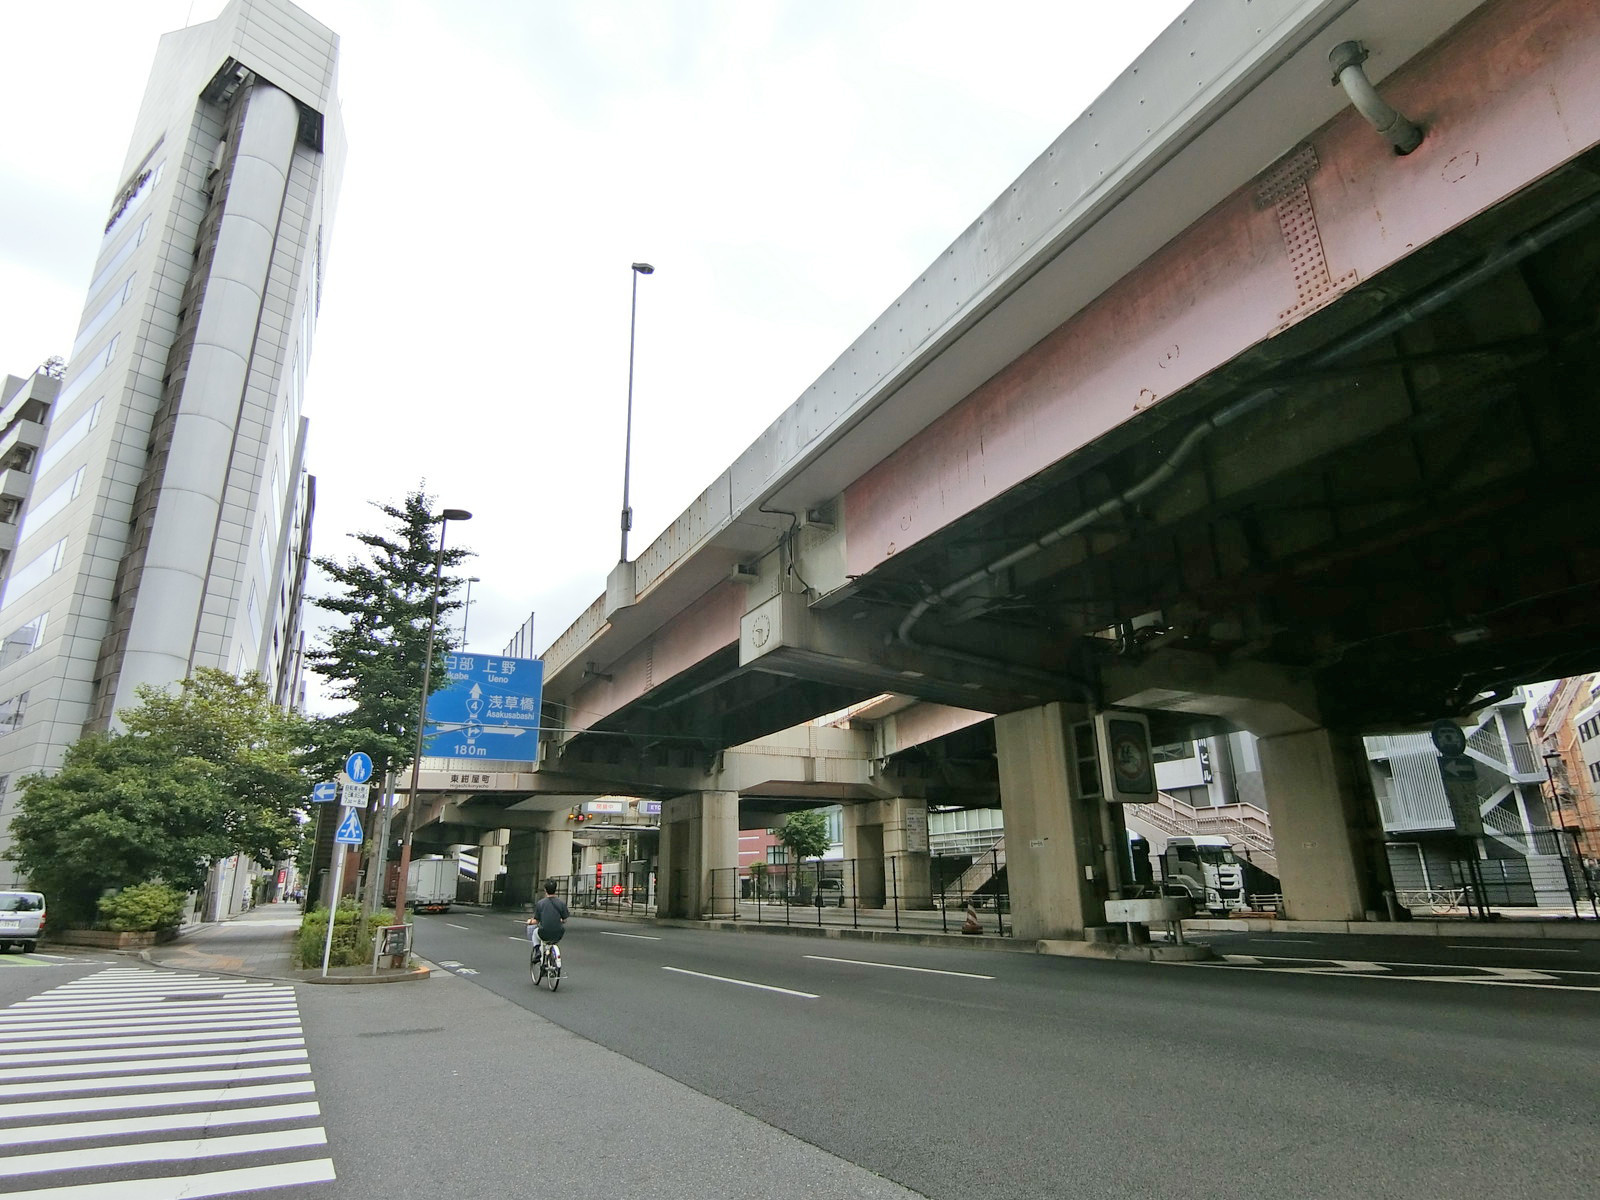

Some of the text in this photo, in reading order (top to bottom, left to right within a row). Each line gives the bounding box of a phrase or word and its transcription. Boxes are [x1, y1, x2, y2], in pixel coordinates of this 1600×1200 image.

[444, 655, 516, 675] 日部 上野
[488, 674, 509, 684] Ueno
[470, 701, 479, 711] 4
[488, 694, 535, 711] 浅草橋
[486, 710, 534, 720] Asakusabashi
[454, 744, 487, 756] 180m
